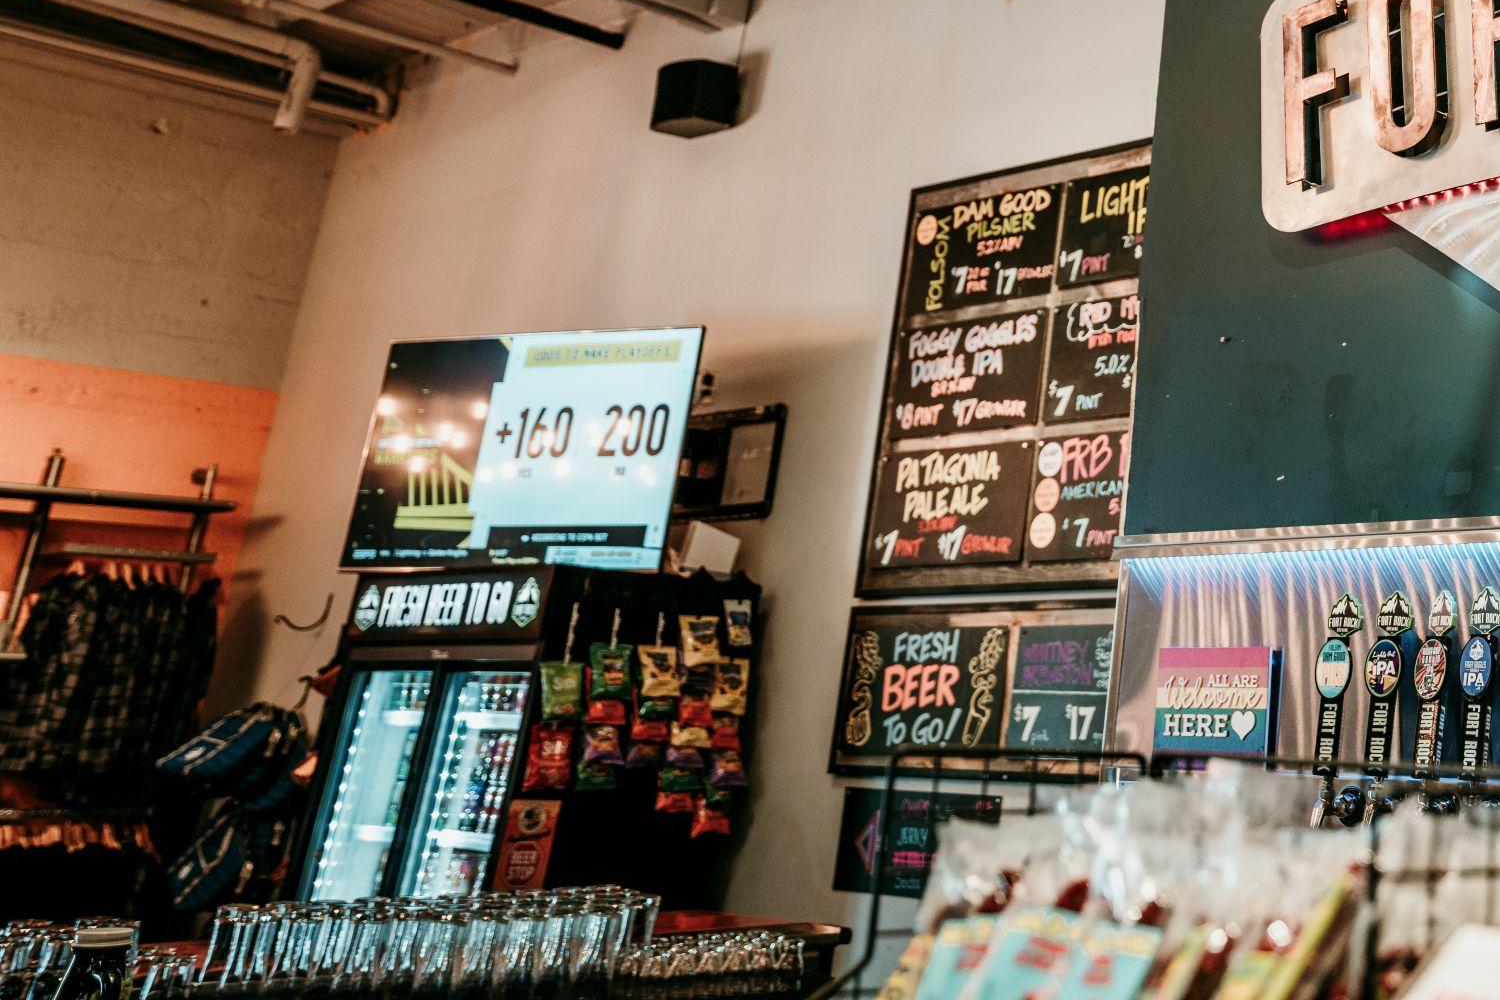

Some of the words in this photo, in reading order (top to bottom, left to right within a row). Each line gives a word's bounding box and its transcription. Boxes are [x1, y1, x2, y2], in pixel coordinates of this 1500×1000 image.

[953, 198, 994, 229] DAM
[999, 189, 1051, 217] GOOD
[1080, 176, 1149, 224] LIGHT
[966, 212, 1036, 242] PILSNER
[925, 215, 952, 311] FOLSOM
[909, 327, 963, 359] FOGGY
[971, 348, 1004, 377] IPA
[1048, 379, 1075, 417] $7
[1075, 392, 1104, 412] PINT
[913, 403, 945, 428] PINT
[496, 406, 574, 459] +160
[895, 450, 1001, 493] PATAGONIA
[1060, 434, 1113, 484] FRB
[903, 487, 950, 523] PALE
[950, 483, 989, 516] ALE
[1060, 479, 1124, 500] AMERICAN
[1085, 529, 1117, 548] PINT
[377, 585, 430, 628] FRESH
[1328, 617, 1343, 628] FORT
[1343, 617, 1359, 628] ROCK
[1378, 616, 1392, 628] FORT
[1393, 615, 1410, 627] ROCK
[1471, 613, 1485, 624] FORT
[1486, 612, 1500, 624] ROCK
[893, 628, 960, 663] FRESH
[881, 663, 960, 712] BEER
[1164, 675, 1263, 710] Welcome
[1207, 674, 1230, 688] ALL
[1232, 674, 1259, 688] ARE
[1462, 672, 1485, 687] IPA
[911, 707, 962, 748] GO!
[1014, 702, 1041, 742] $7
[1064, 703, 1096, 741] $17
[1163, 713, 1230, 738] HERE
[1321, 703, 1338, 735] FORT
[1372, 702, 1389, 734] FORT
[1420, 704, 1434, 737] FORT
[1466, 704, 1481, 737] FORT
